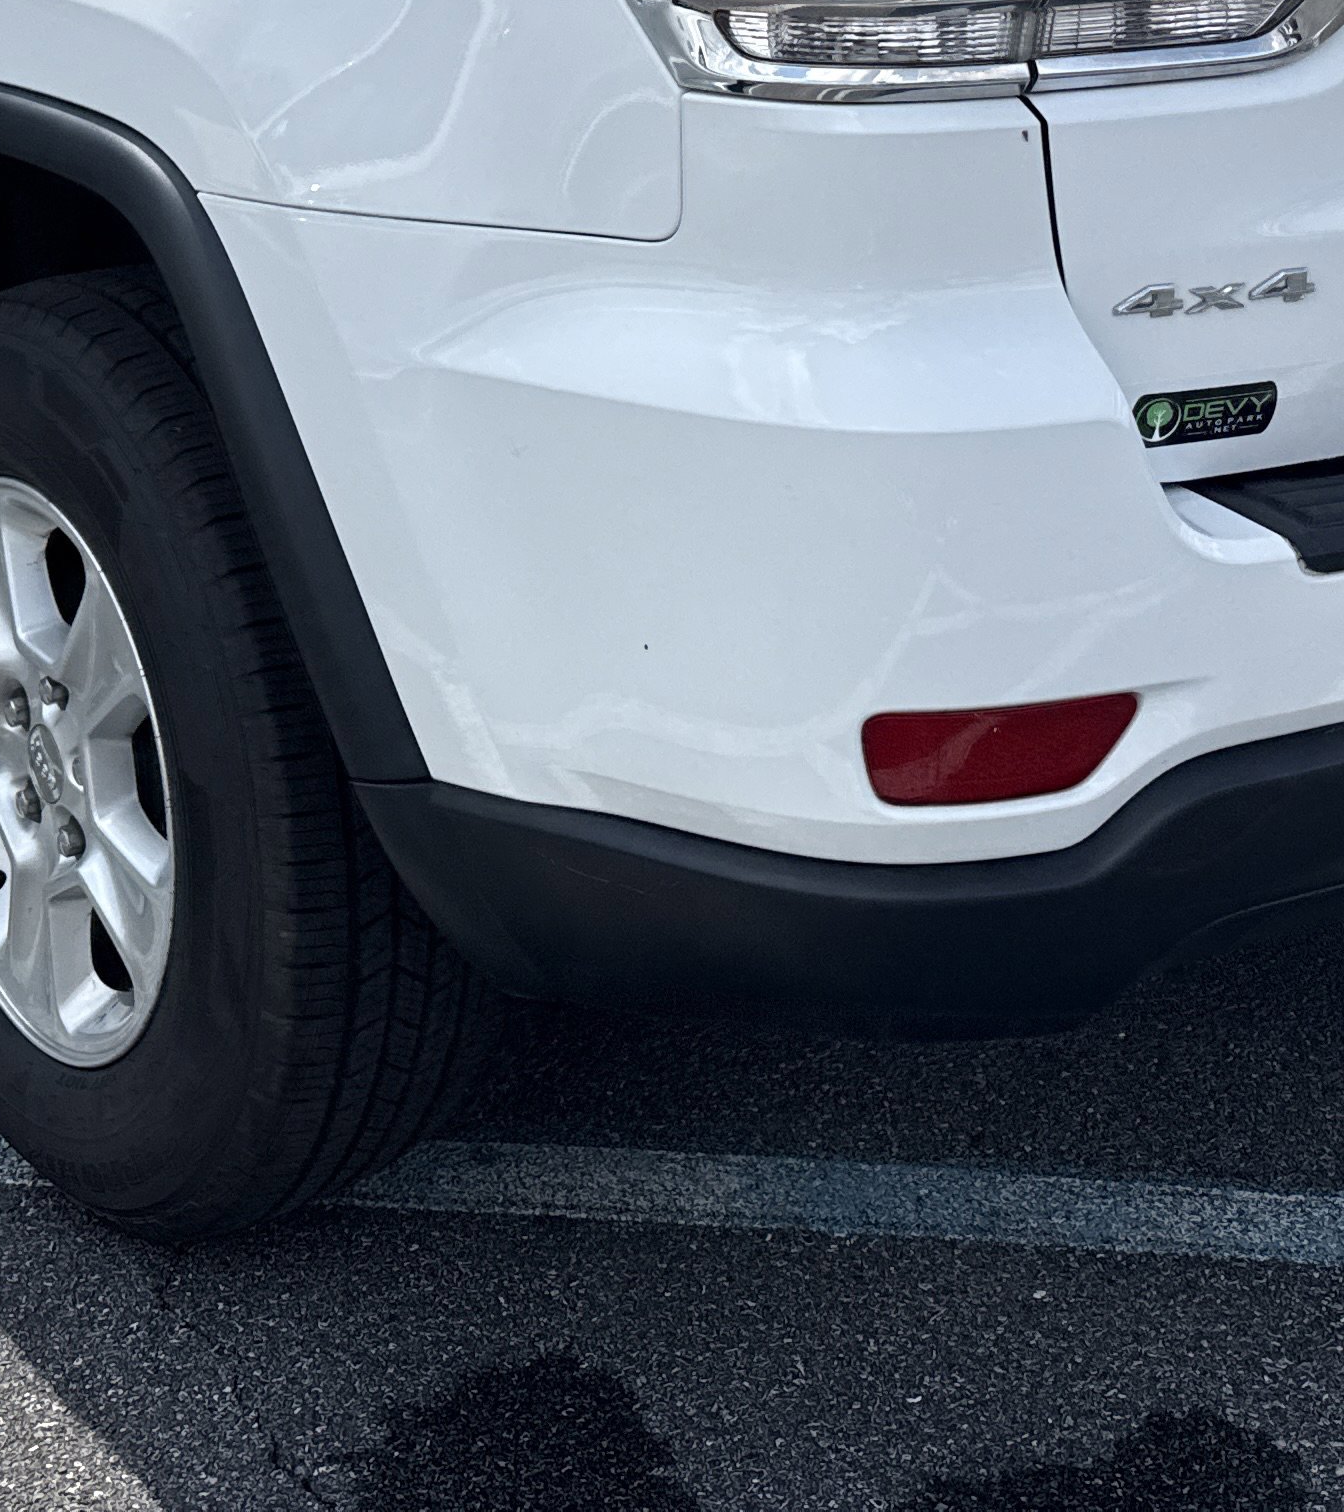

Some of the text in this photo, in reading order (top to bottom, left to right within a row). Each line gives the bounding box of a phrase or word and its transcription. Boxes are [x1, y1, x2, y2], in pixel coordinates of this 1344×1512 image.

[1112, 266, 1316, 318] 4x4
[1182, 393, 1273, 422] DEVY
[1185, 413, 1264, 431] AUTO PARK
